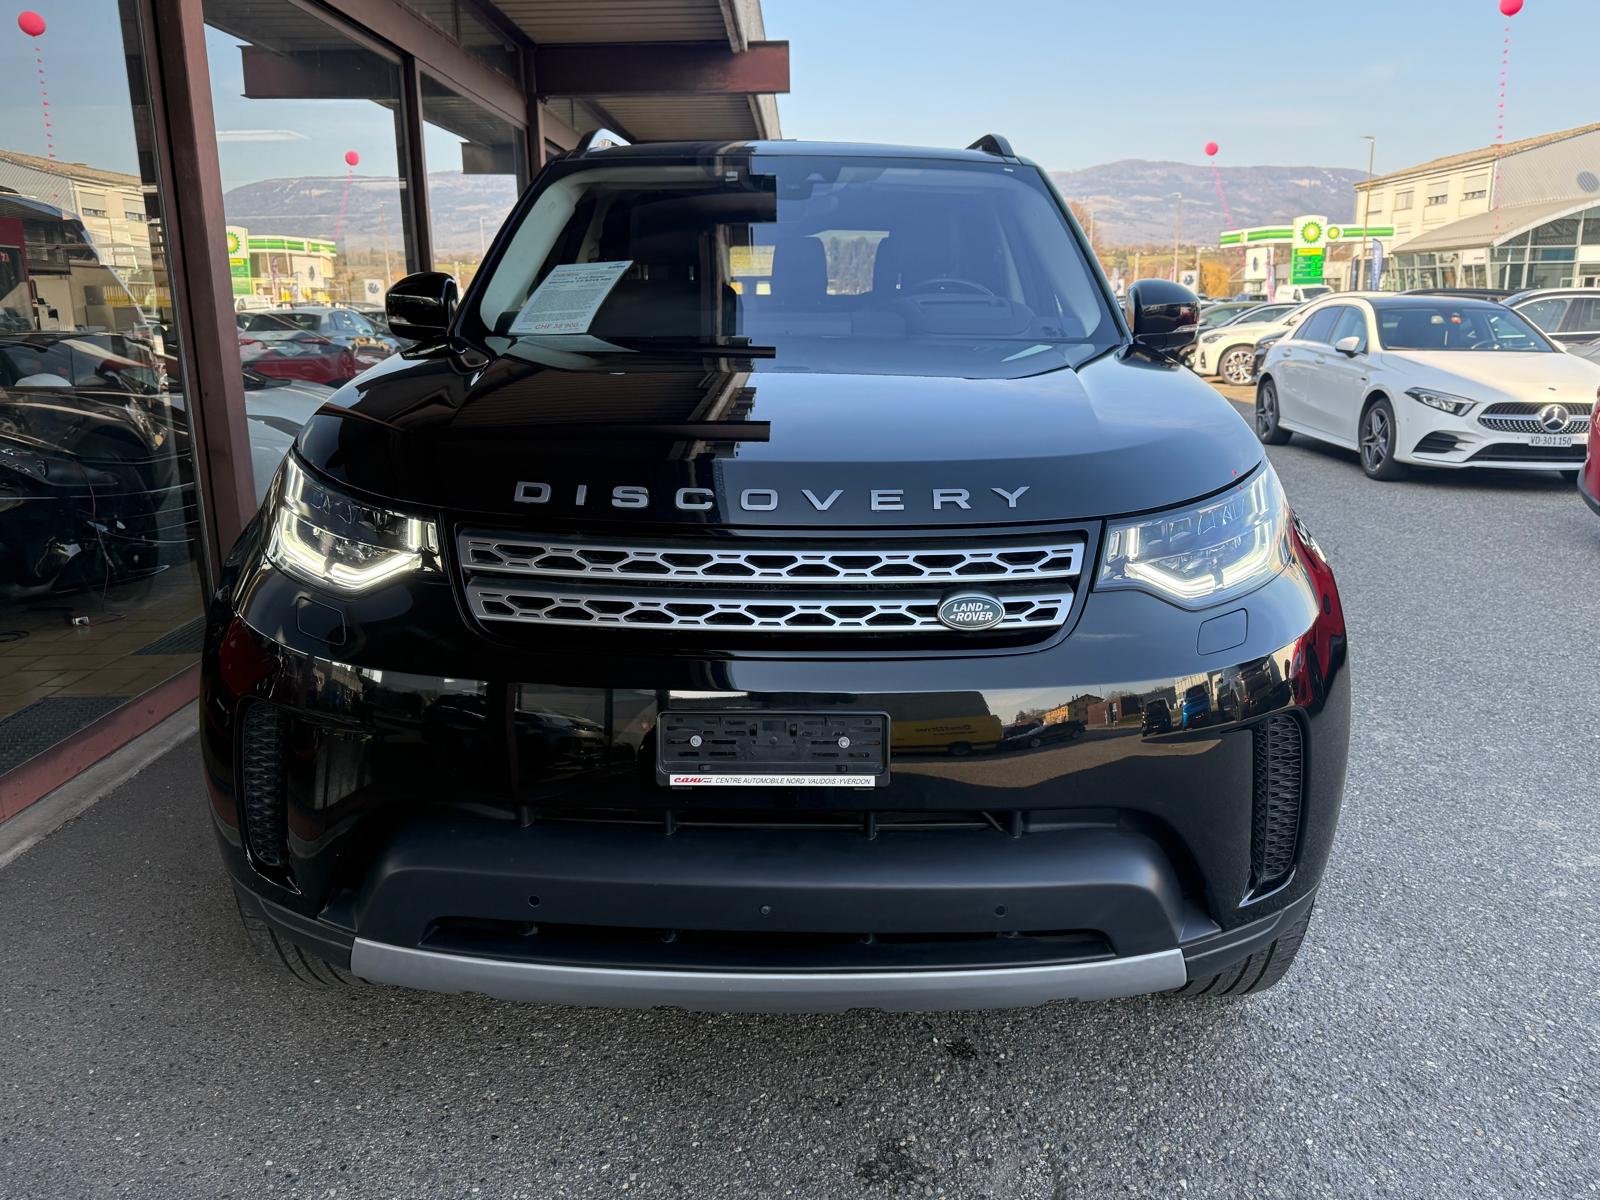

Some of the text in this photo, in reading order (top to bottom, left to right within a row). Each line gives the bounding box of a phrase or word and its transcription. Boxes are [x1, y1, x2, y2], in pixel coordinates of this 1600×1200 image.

[514, 480, 1031, 512] DISCOVERY
[952, 602, 983, 612] LAND
[956, 611, 993, 622] ROVER
